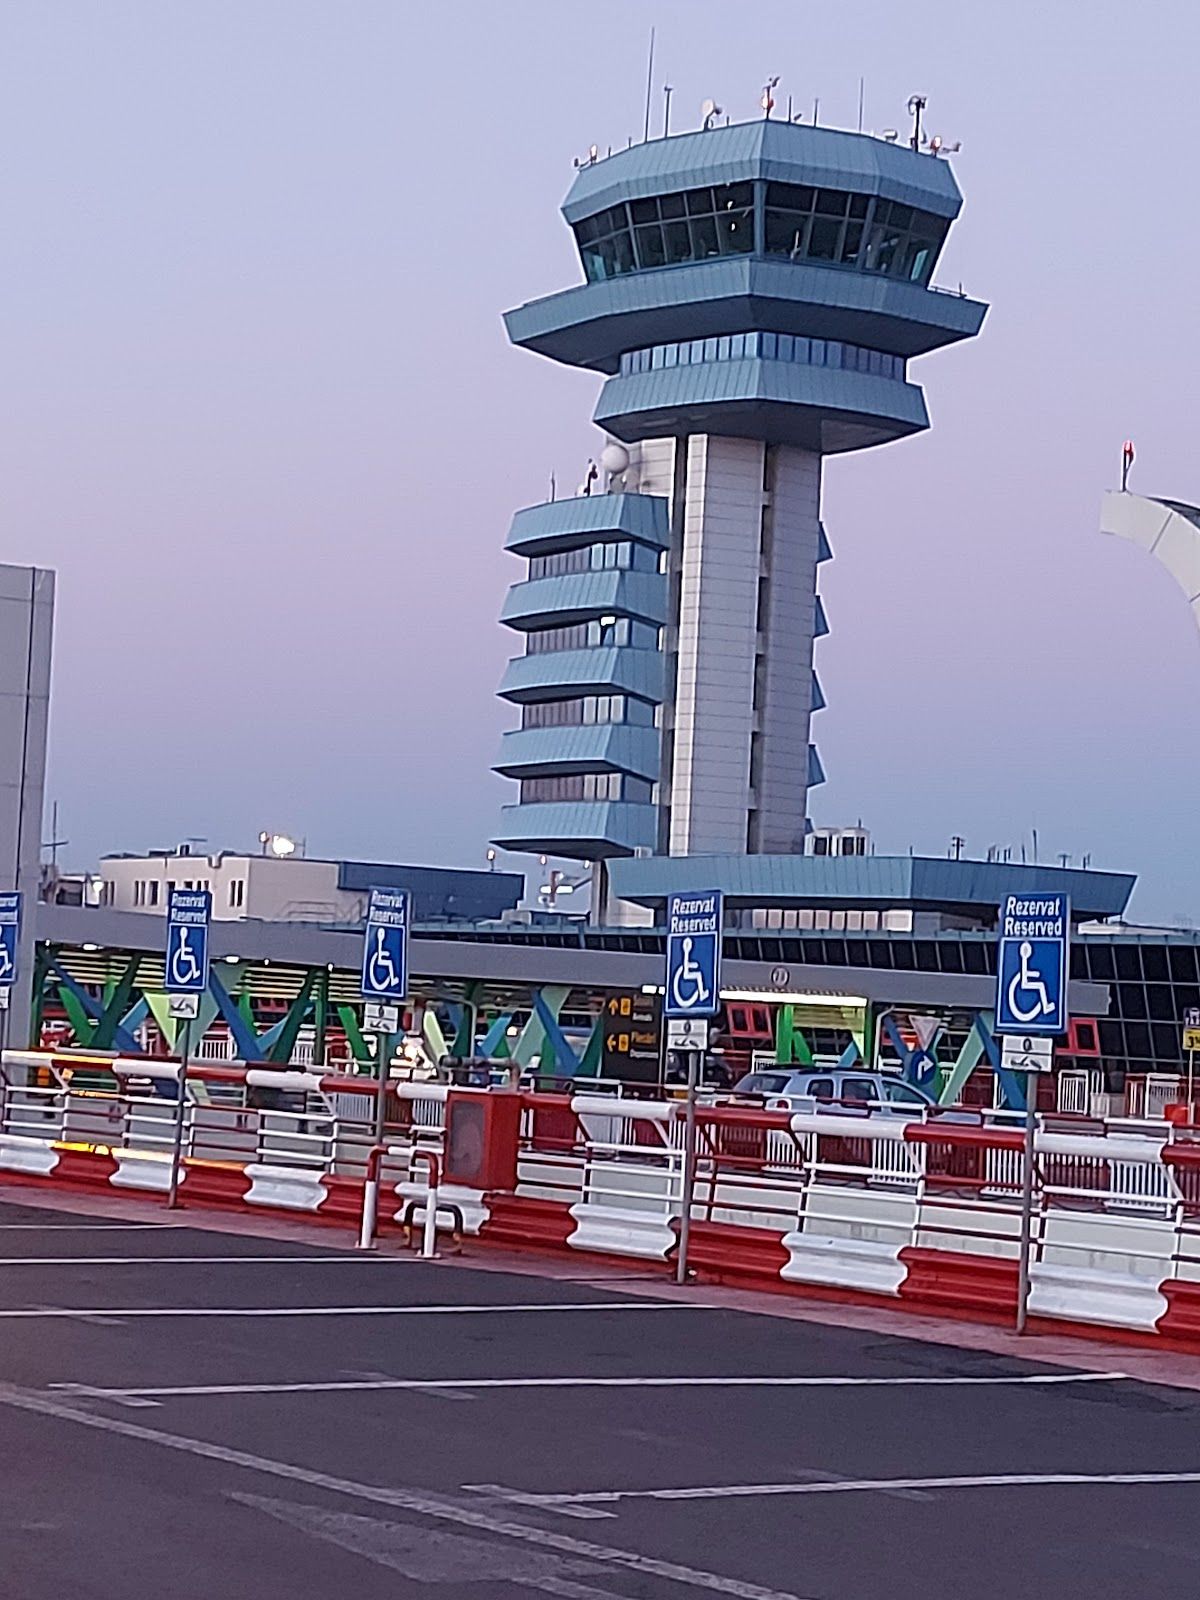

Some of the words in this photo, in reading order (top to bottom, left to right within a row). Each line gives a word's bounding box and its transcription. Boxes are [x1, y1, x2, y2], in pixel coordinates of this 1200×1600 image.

[672, 896, 715, 915] Rezervat
[1006, 896, 1060, 916] Rezervat
[671, 913, 716, 933] Reserved
[1004, 916, 1062, 936] Reserved
